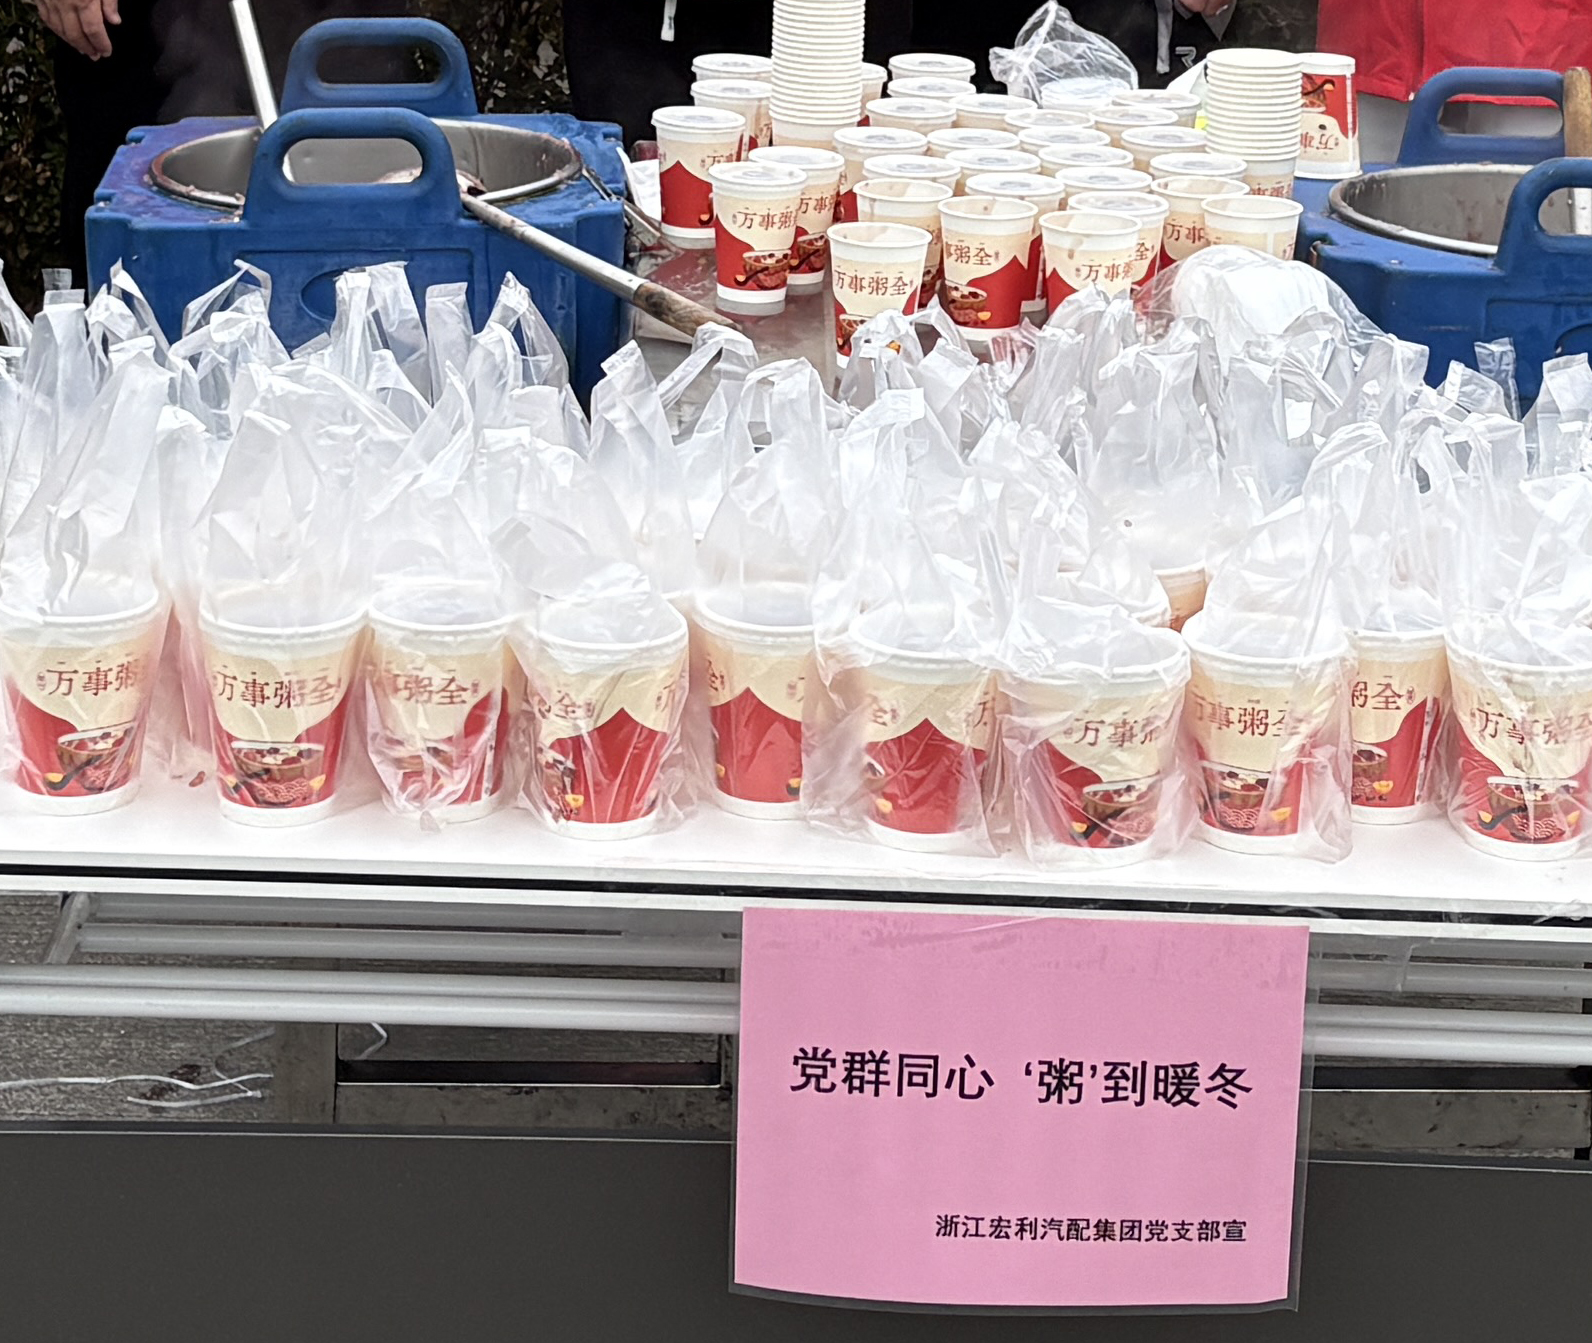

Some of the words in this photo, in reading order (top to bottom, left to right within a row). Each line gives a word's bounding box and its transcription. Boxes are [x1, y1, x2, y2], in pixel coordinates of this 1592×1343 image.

[834, 268, 910, 297] 万事粥全
[789, 1046, 996, 1101] 党群同心
[934, 1213, 1249, 1244] 浙江宏利汽配集团党支部宣
